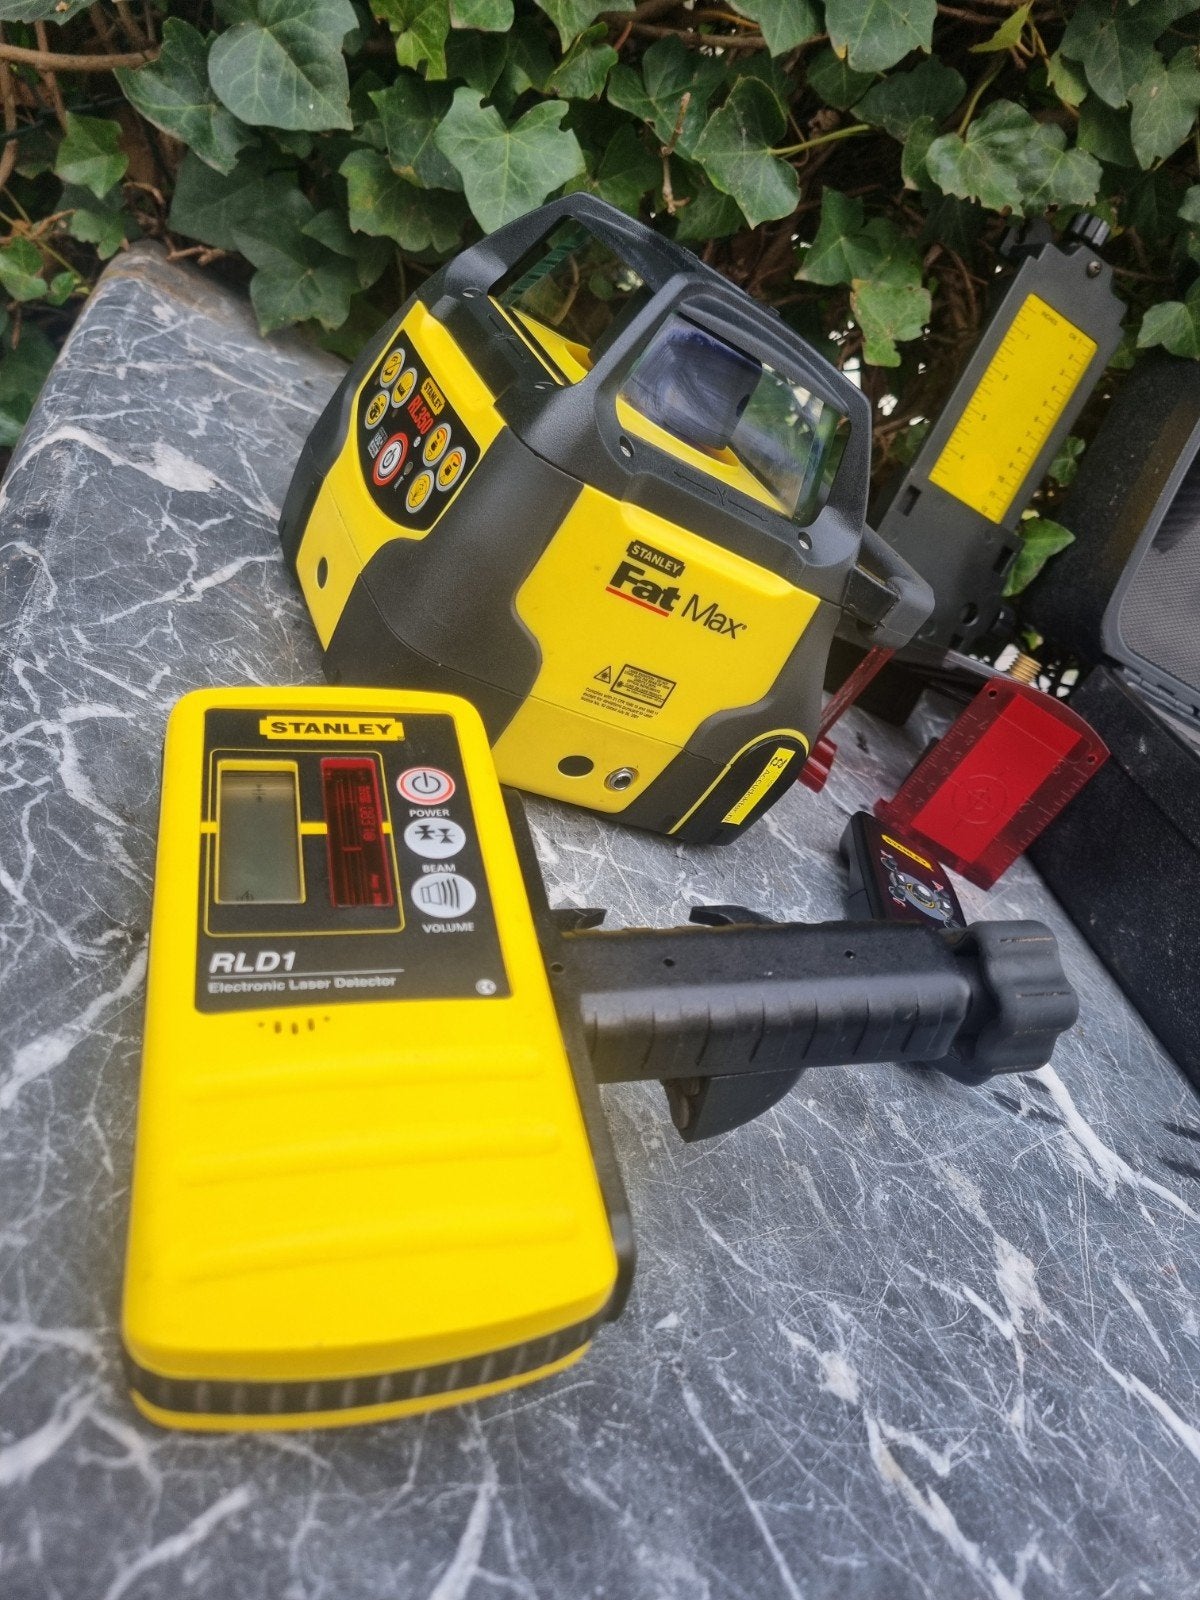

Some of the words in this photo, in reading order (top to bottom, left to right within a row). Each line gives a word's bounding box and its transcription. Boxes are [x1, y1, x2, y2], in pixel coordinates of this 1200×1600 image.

[424, 381, 443, 409] STANLEY
[407, 394, 434, 435] RL350
[631, 544, 681, 574] STANLEY
[609, 561, 681, 612] Fat
[271, 721, 392, 735] STANLEY
[409, 808, 450, 818] POWER
[422, 863, 456, 873] BEAM
[422, 922, 475, 934] VOLUME
[208, 950, 297, 974] RLD1
[208, 979, 286, 994] Electronic
[288, 977, 332, 990] Laser
[333, 975, 397, 989] Detector
